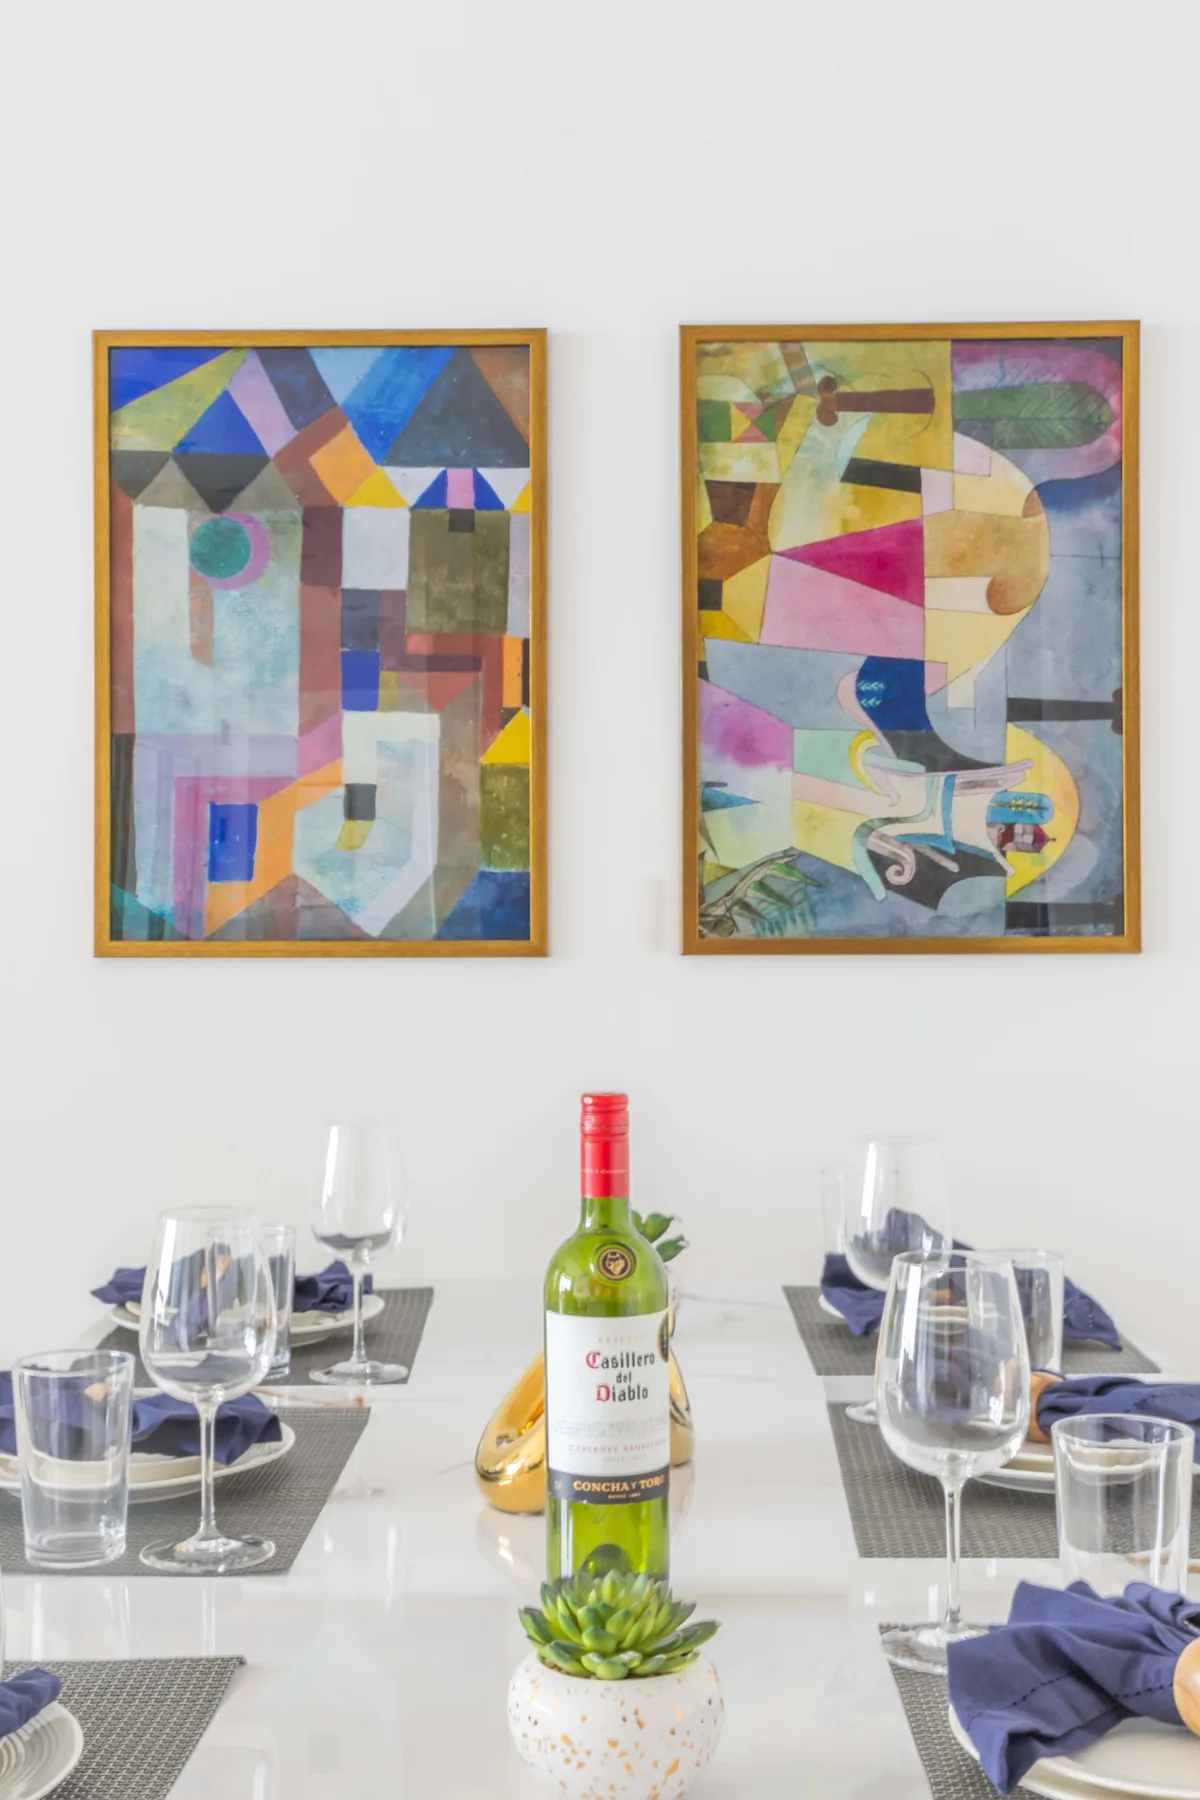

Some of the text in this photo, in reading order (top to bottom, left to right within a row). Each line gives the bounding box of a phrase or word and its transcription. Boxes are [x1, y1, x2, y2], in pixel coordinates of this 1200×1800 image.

[585, 1350, 655, 1369] Casillero
[616, 1371, 632, 1383] del
[596, 1384, 648, 1402] Diablo
[573, 1480, 630, 1492] CONCHA
